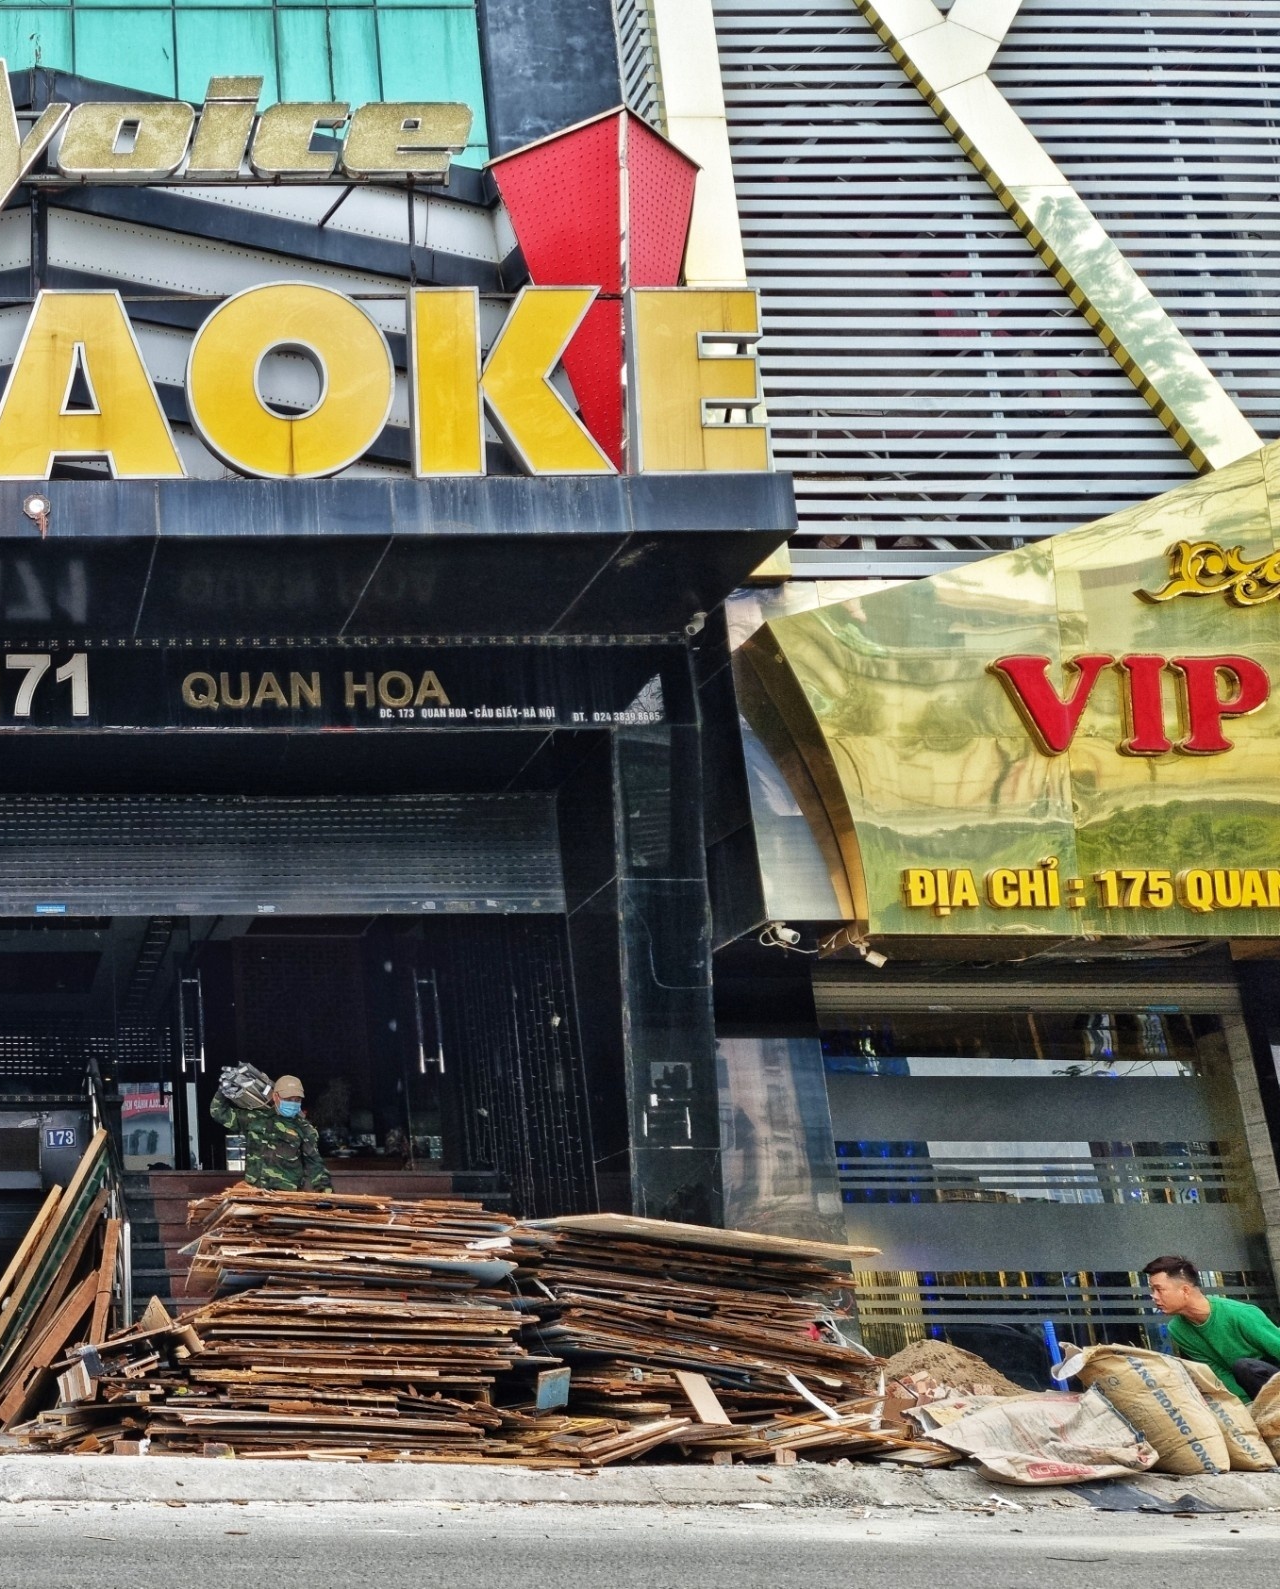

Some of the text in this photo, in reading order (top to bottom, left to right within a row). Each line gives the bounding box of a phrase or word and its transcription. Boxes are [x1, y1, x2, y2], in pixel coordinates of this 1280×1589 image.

[182, 670, 451, 711] QUAN HOA
[986, 653, 1271, 757] VIP
[398, 708, 415, 718] 173
[421, 708, 447, 719] QUAN
[448, 708, 468, 718] HOA
[594, 711, 612, 722] 024
[902, 868, 980, 916] ĐỊA
[983, 855, 1061, 908] CHỈ
[1092, 869, 1174, 908] 175
[48, 1129, 75, 1147] 173
